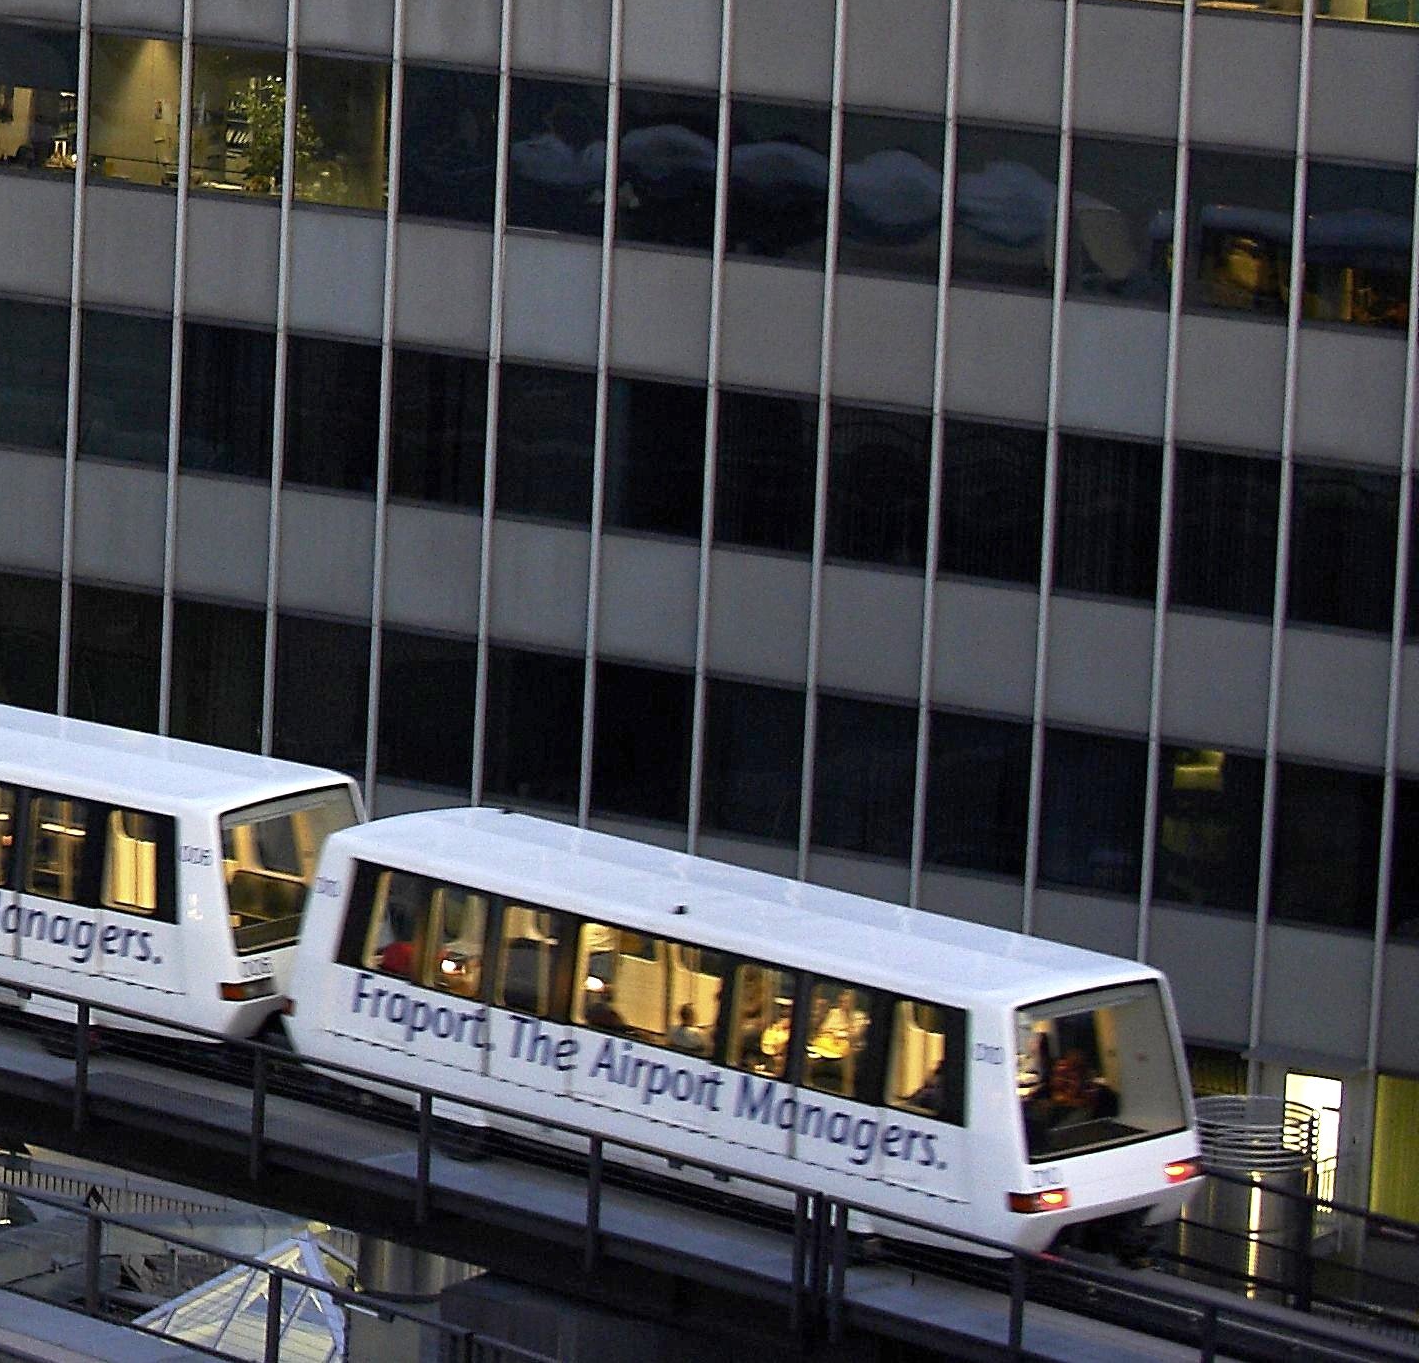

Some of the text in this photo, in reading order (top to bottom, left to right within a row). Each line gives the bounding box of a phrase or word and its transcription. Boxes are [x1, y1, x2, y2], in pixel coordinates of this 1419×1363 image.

[352, 972, 947, 1171] Fraport. The Airport Managers.
